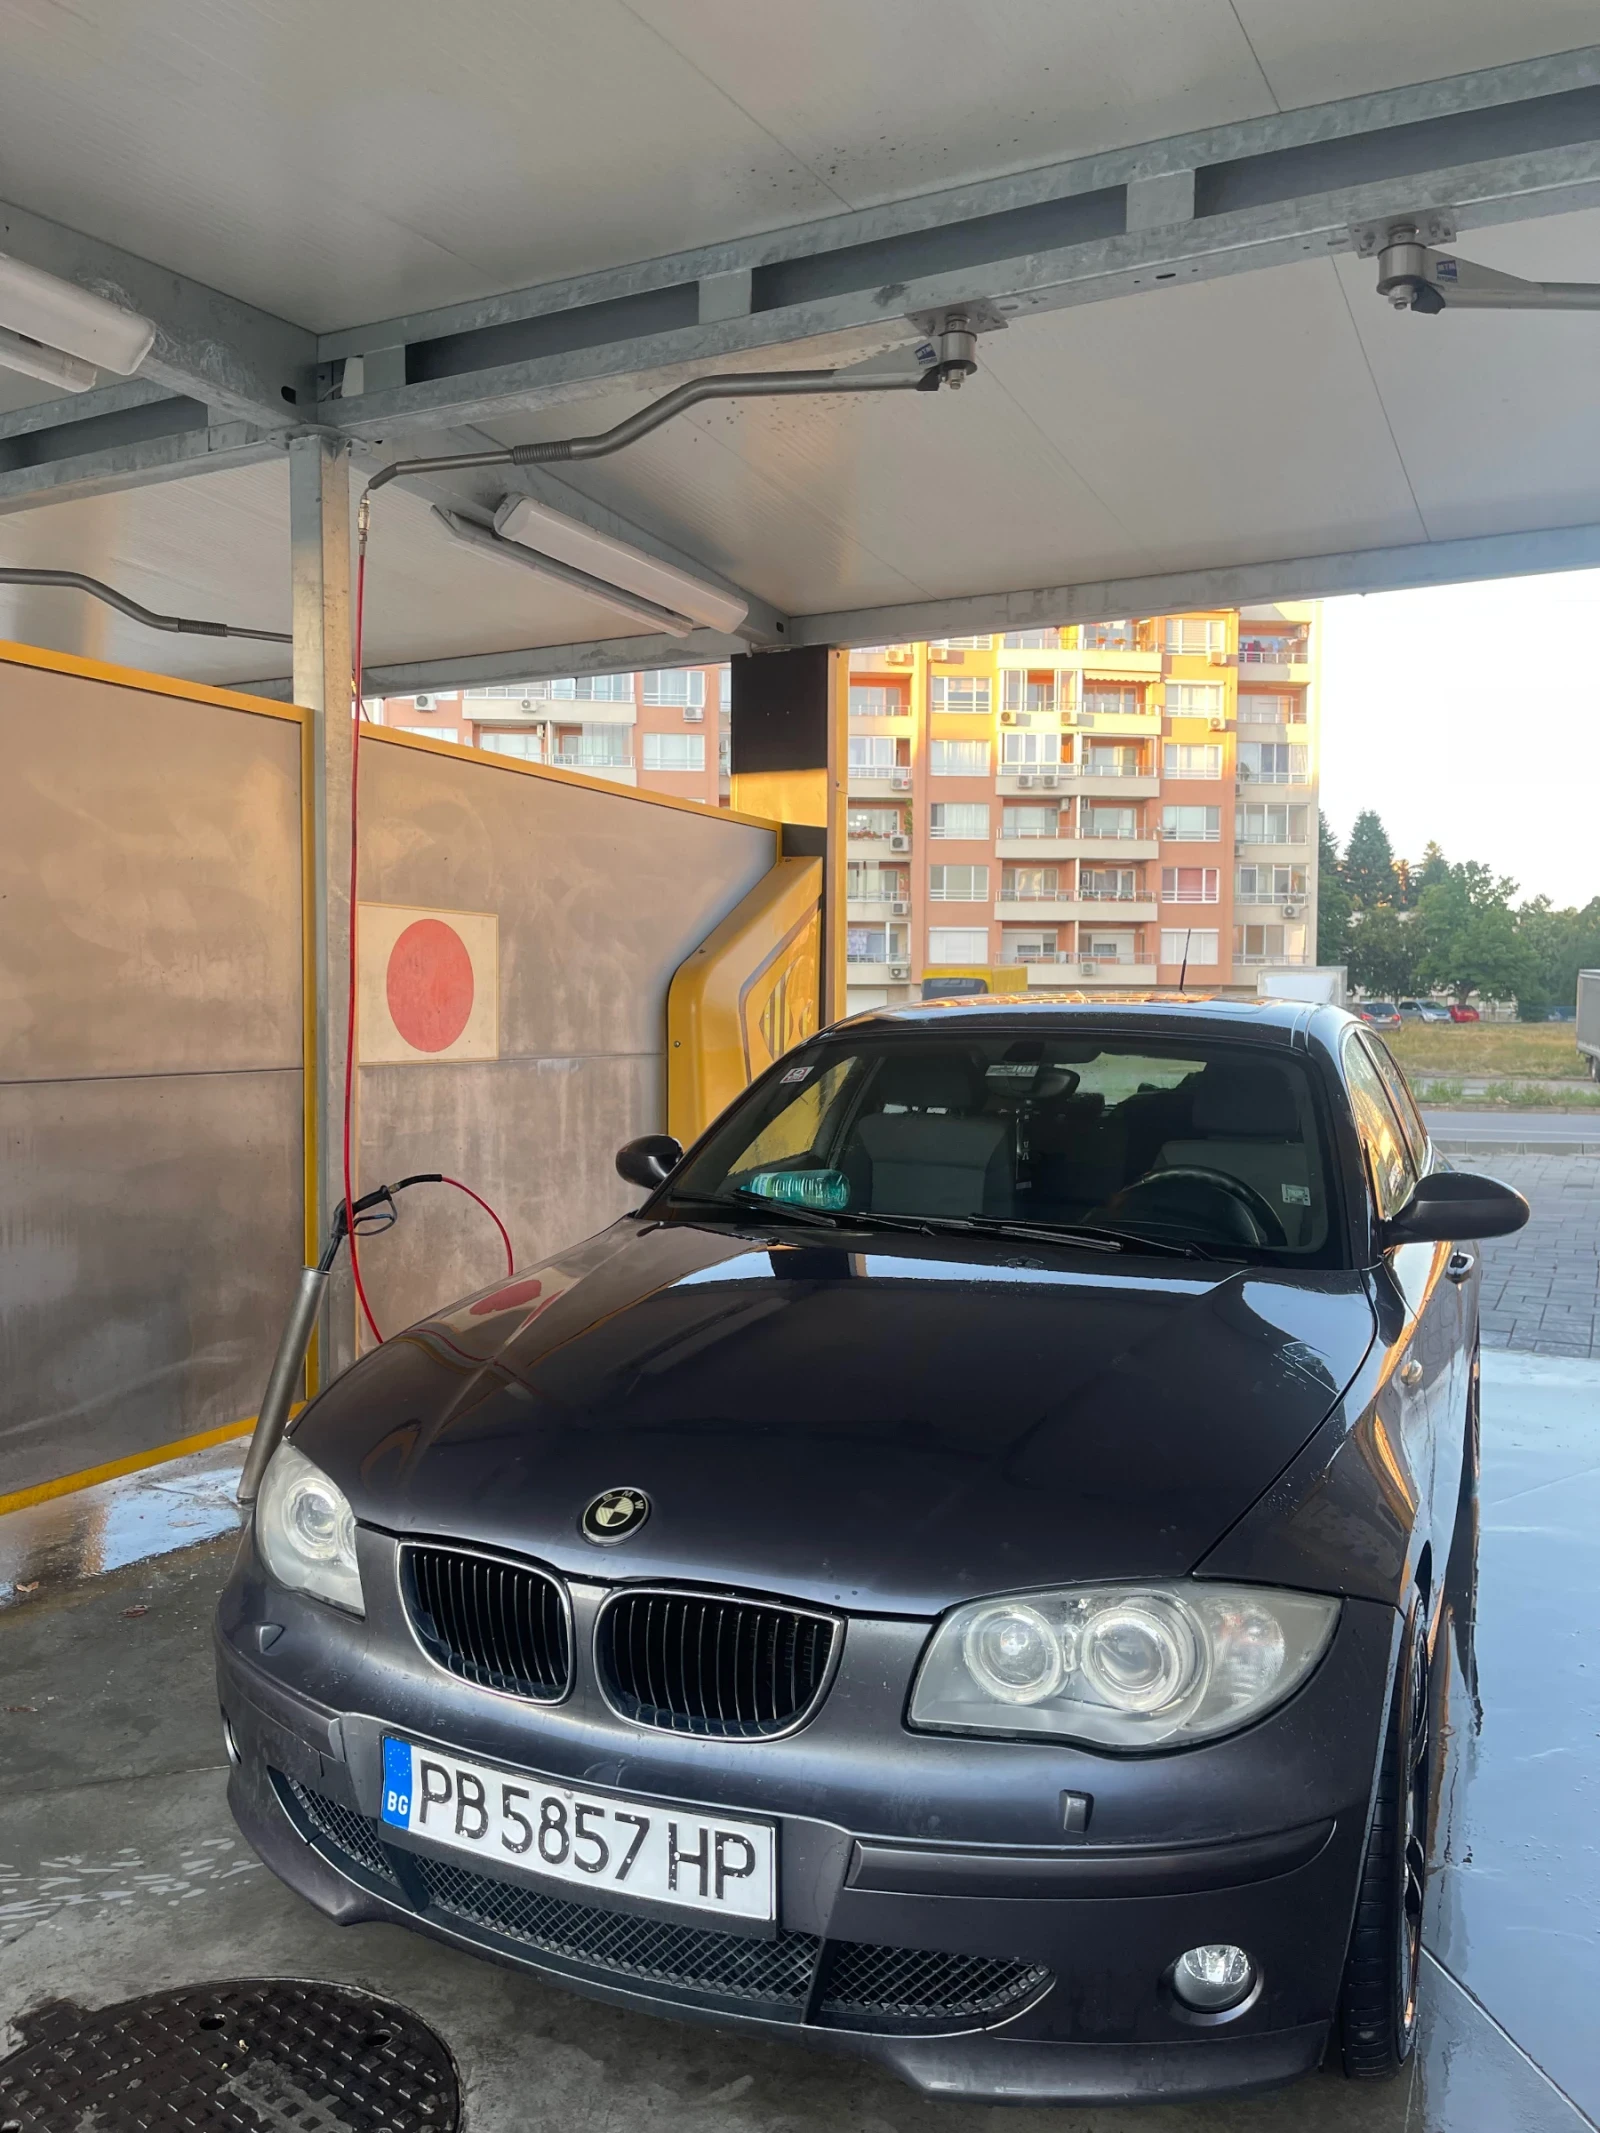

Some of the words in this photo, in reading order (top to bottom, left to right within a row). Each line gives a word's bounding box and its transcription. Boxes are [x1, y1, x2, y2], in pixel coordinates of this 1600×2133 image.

[602, 1490, 645, 1510] BMW
[387, 1790, 409, 1815] BG
[420, 1759, 489, 1840] PB
[501, 1783, 650, 1881] 5857
[668, 1821, 756, 1900] HP
